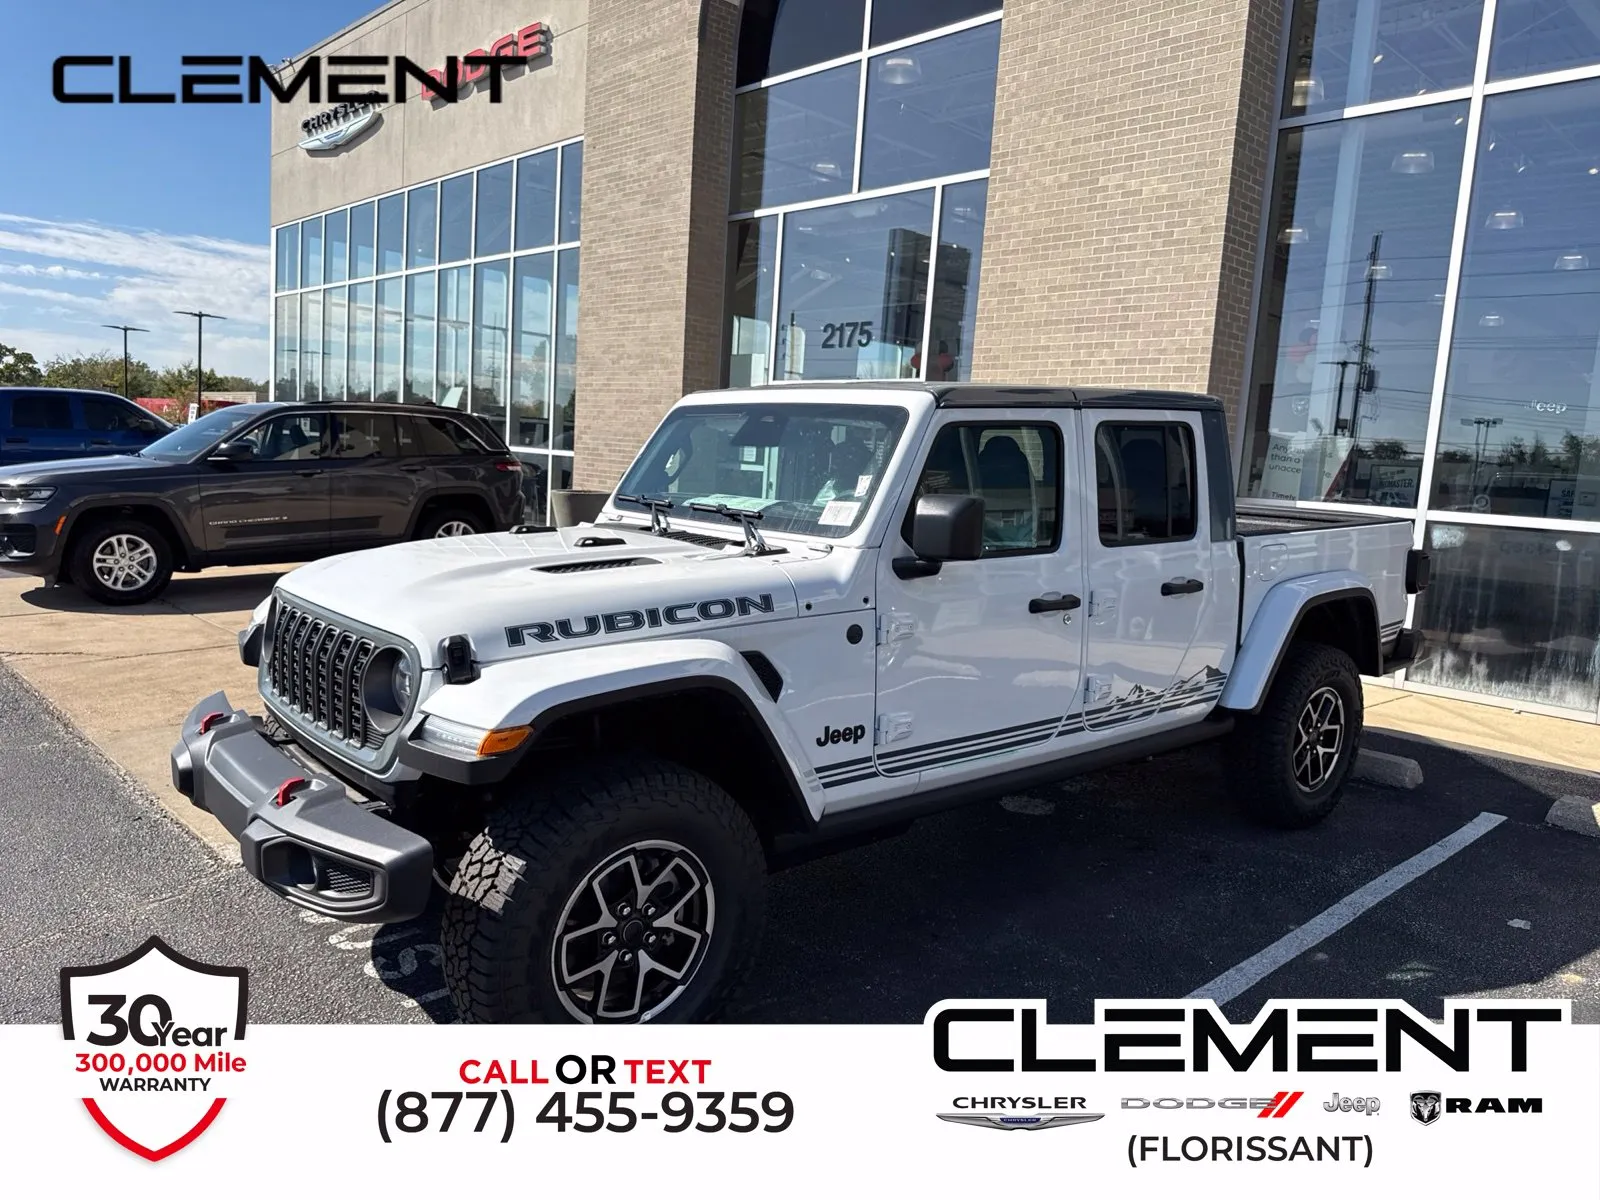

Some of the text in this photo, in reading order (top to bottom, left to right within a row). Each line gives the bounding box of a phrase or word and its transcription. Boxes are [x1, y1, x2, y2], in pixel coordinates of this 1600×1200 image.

[301, 90, 382, 132] CHRYSL
[821, 320, 874, 349] 2175
[505, 593, 775, 648] RUBICON
[816, 723, 865, 747] Jeep
